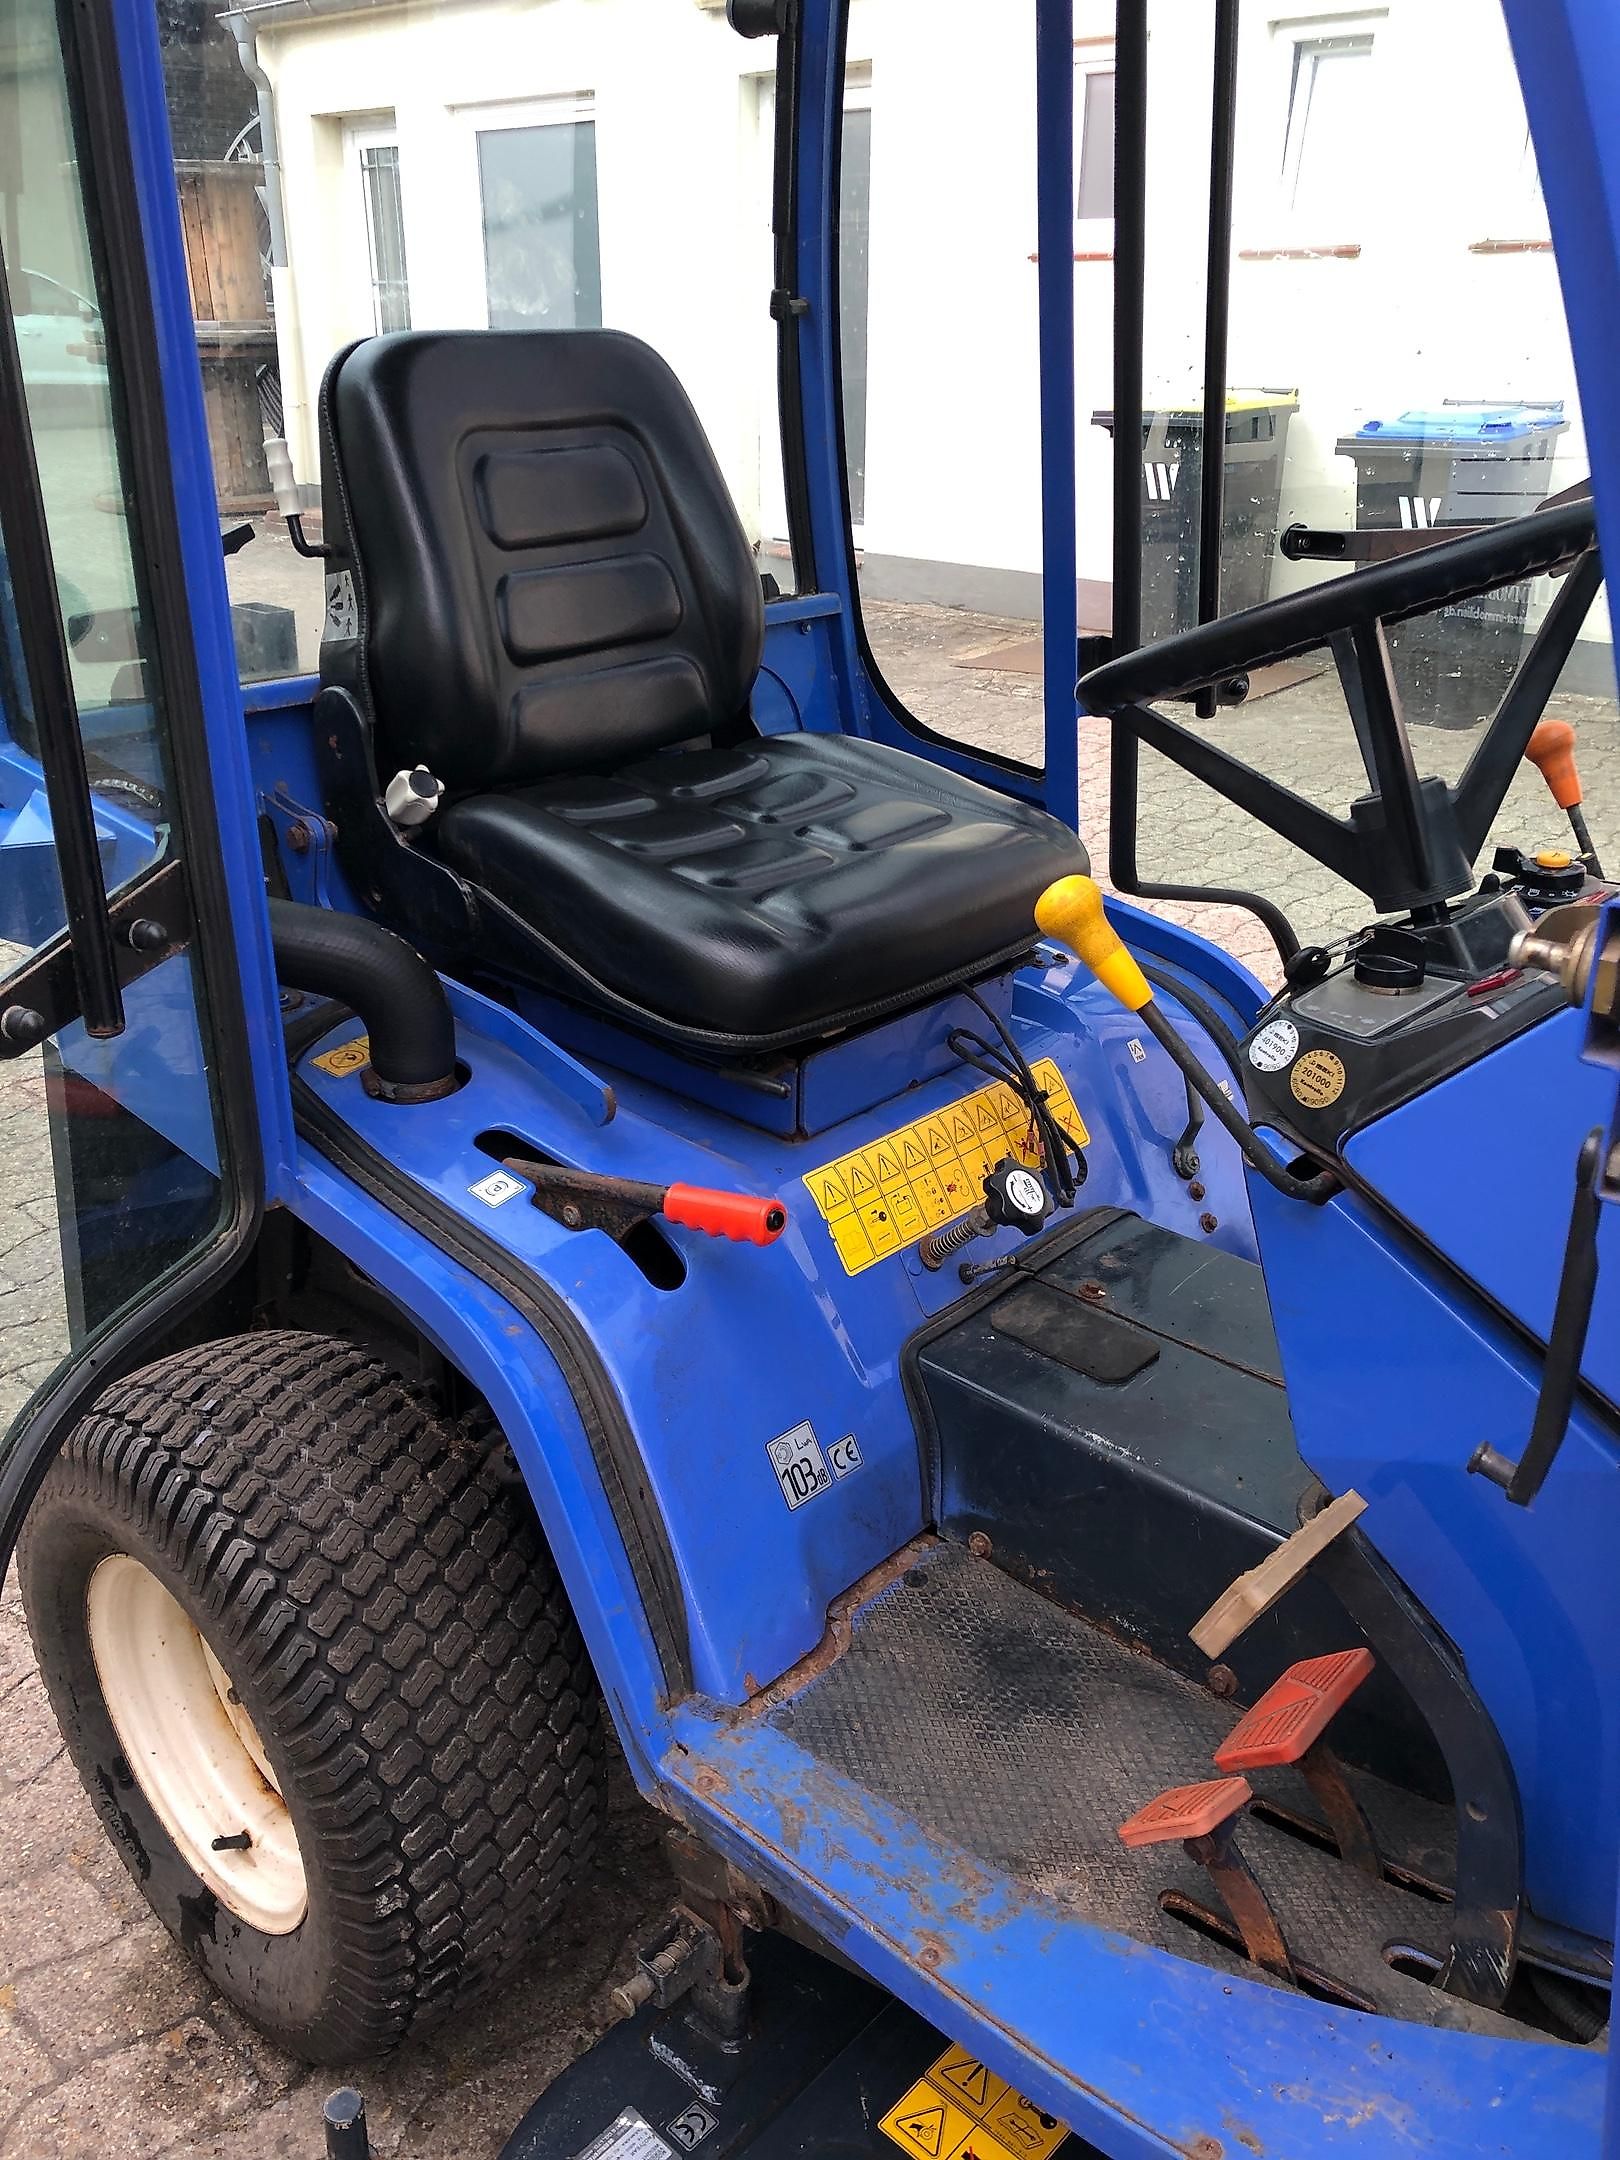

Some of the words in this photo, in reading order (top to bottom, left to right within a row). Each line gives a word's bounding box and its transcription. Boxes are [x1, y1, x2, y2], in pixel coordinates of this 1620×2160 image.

[1302, 1066, 1331, 1088] 201000
[834, 1440, 858, 1469] CE
[782, 1457, 818, 1501] 103
[816, 1468, 828, 1486] dB
